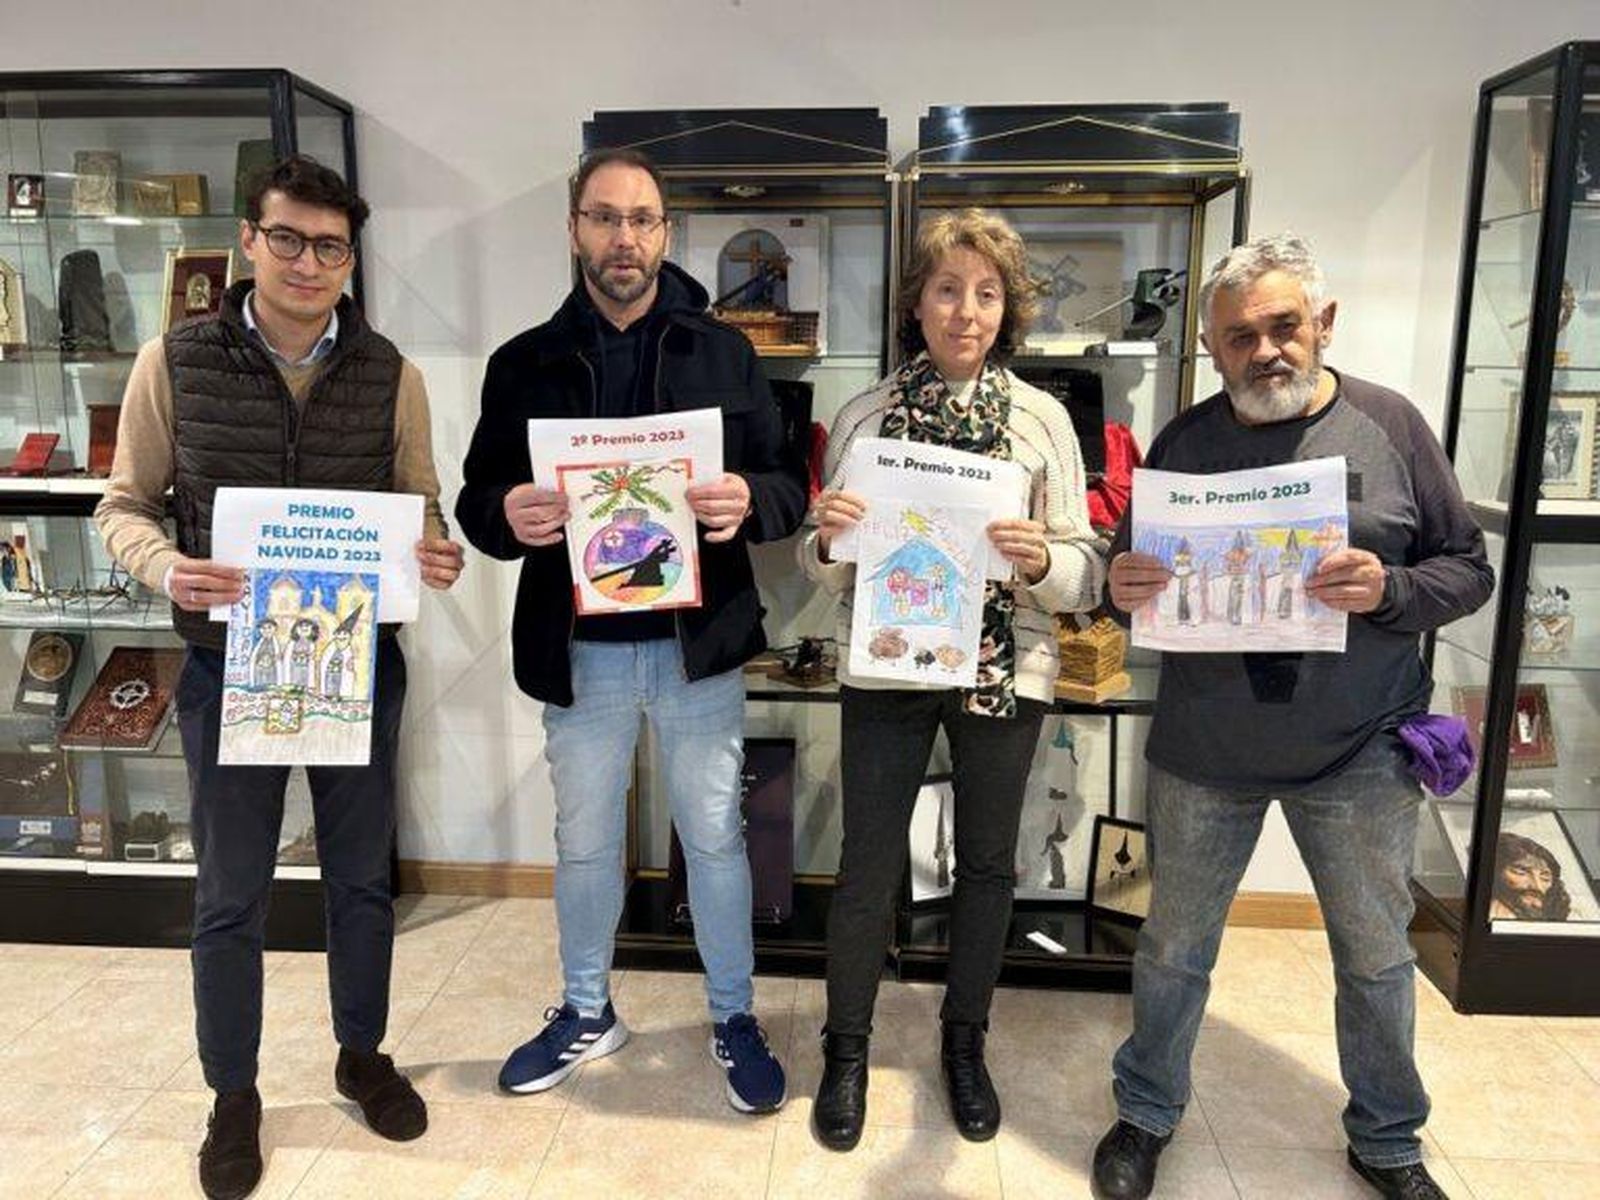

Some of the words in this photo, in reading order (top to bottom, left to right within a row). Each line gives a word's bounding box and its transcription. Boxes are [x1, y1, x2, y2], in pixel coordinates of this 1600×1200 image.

[571, 434, 588, 447] 2º
[591, 433, 646, 446] Premio
[649, 430, 685, 442] 2023
[904, 456, 955, 475] Premio
[958, 466, 992, 481] 2023
[1168, 491, 1200, 504] 3er.
[1205, 487, 1268, 504] Premio
[1271, 482, 1311, 498] 2023
[288, 504, 355, 520] PREMIO
[261, 525, 379, 542] FELICITACIÓN
[257, 545, 339, 559] NAVIDAD
[343, 549, 382, 561] 2023
